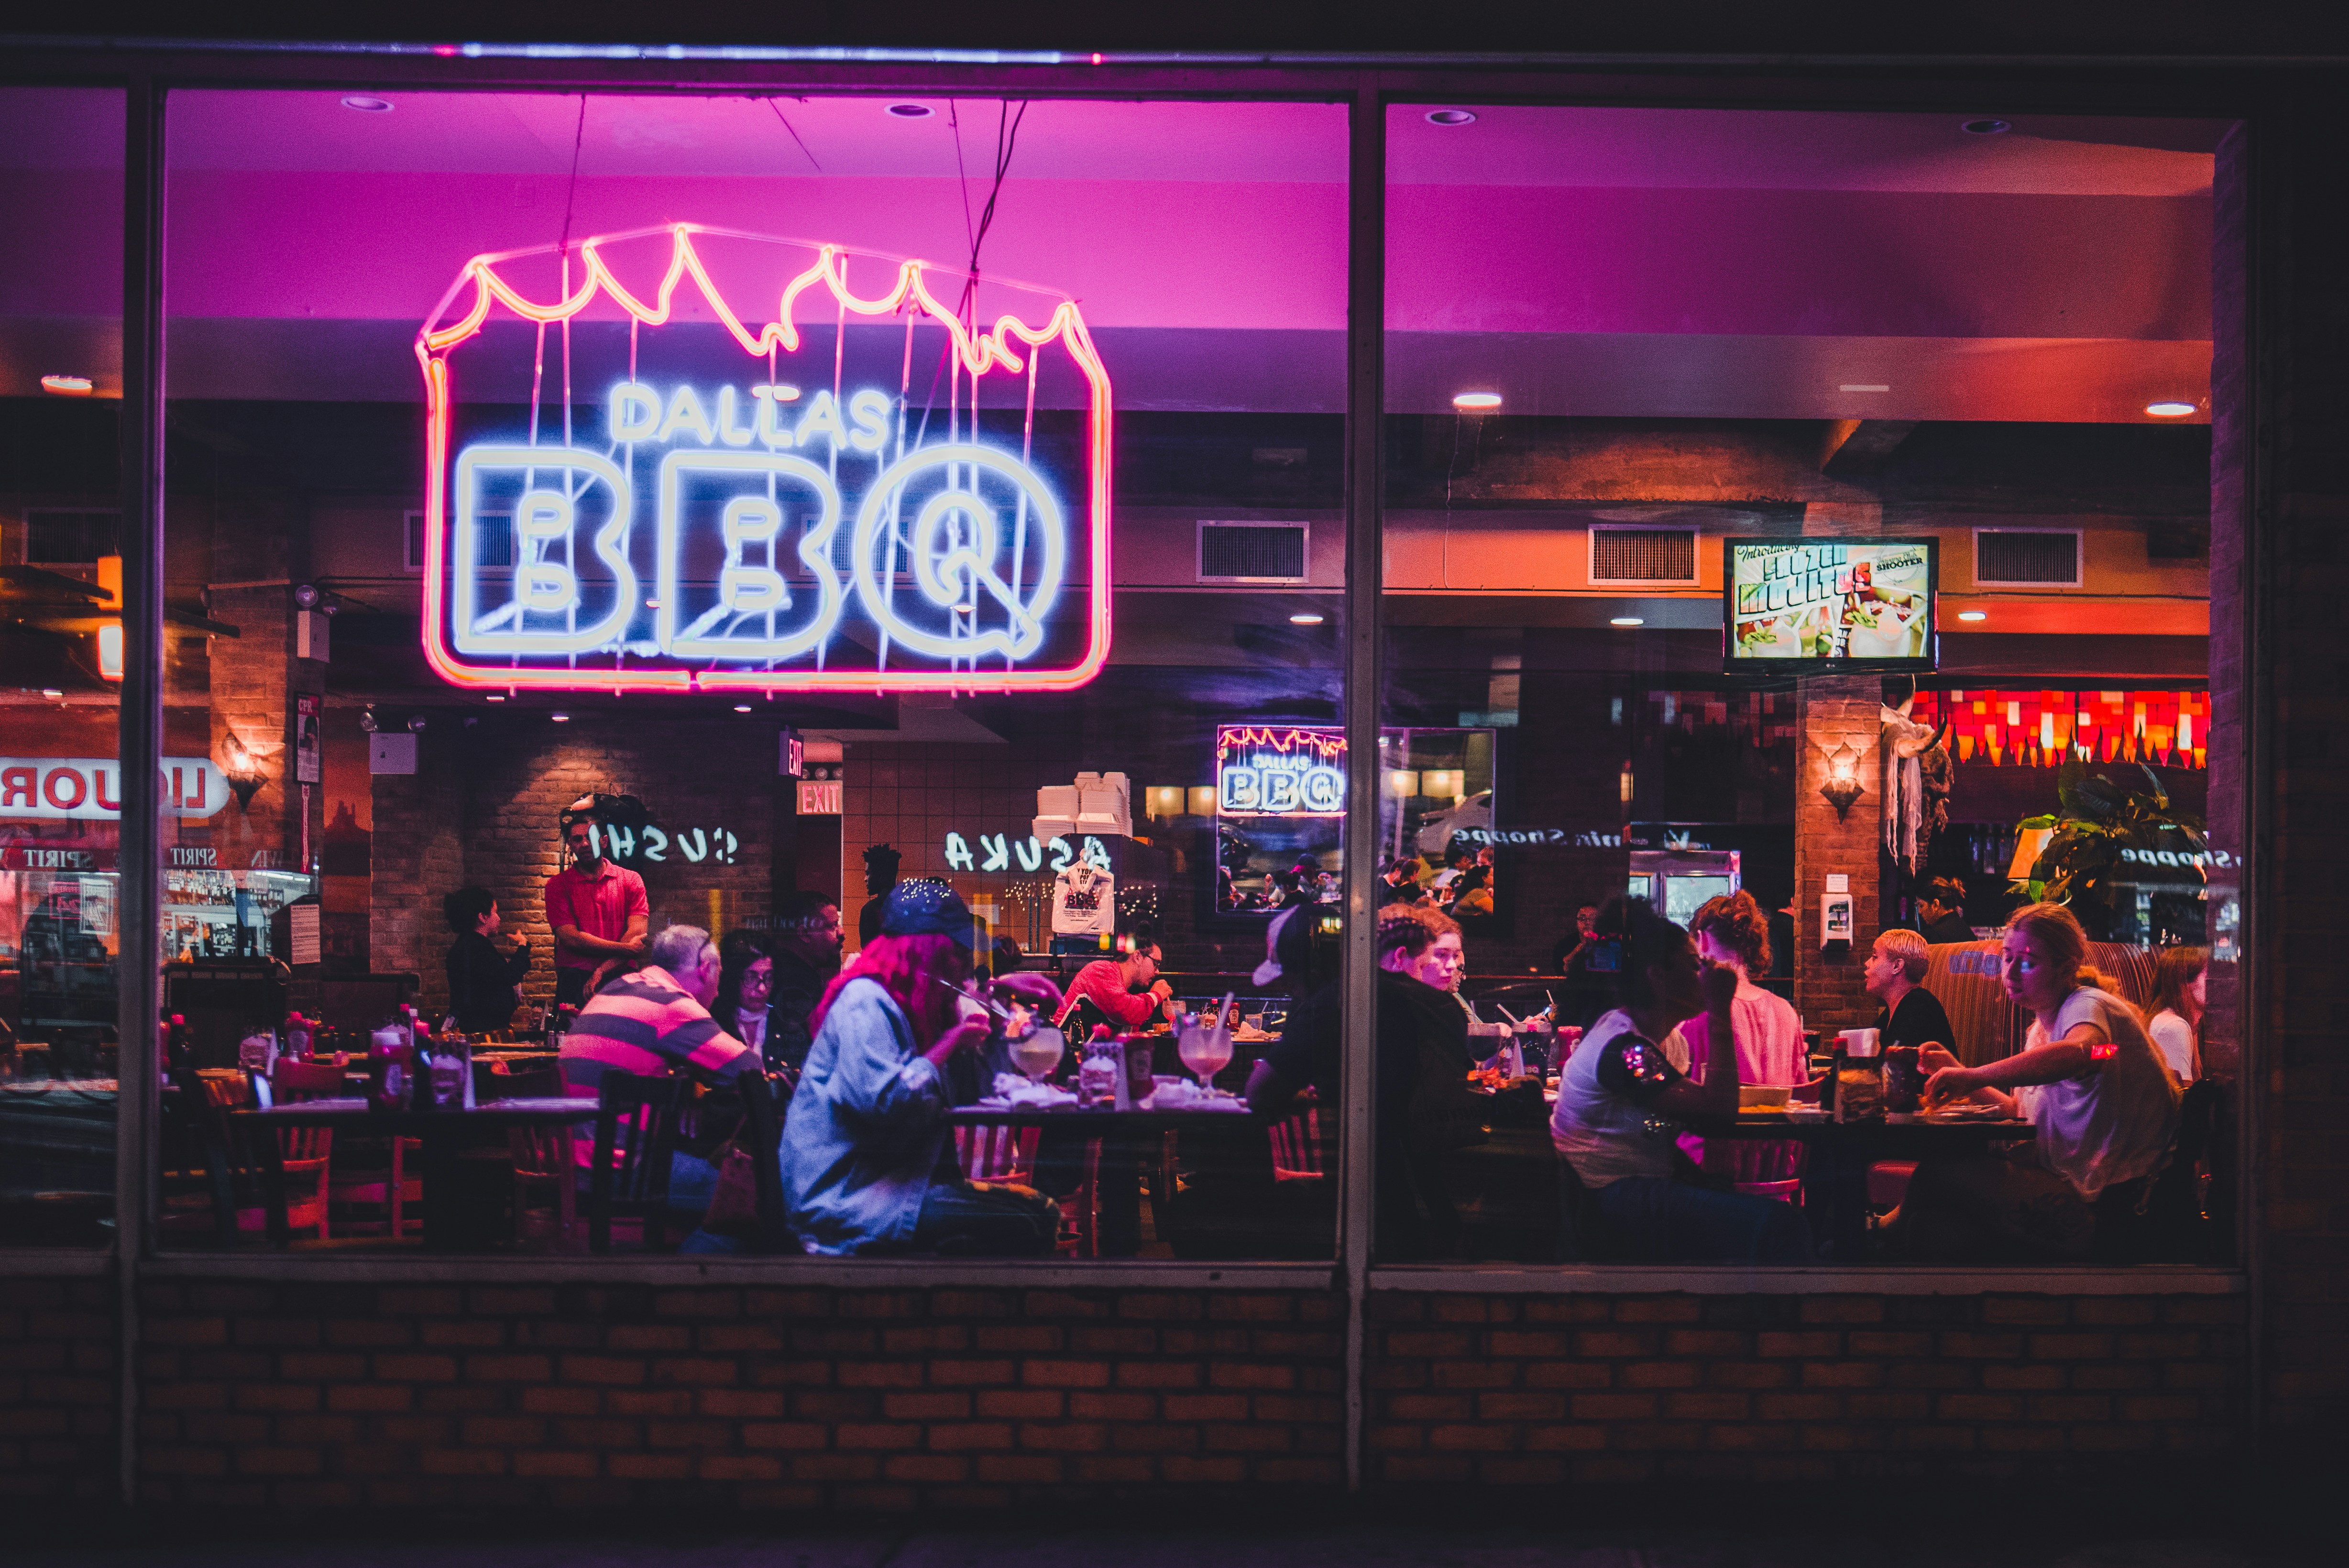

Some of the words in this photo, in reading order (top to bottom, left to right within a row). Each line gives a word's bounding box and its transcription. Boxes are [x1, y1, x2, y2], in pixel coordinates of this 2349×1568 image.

[609, 384, 891, 450] DALLAS
[455, 444, 1065, 659] BBQ
[1877, 558, 1923, 571] SHOOTER
[1738, 562, 1871, 615] MOJITOS
[298, 698, 313, 713] CPR
[789, 738, 802, 777] EXIT
[1252, 755, 1309, 771] DALLAS
[802, 785, 840, 812] EXIT
[1222, 766, 1344, 811] BBQ
